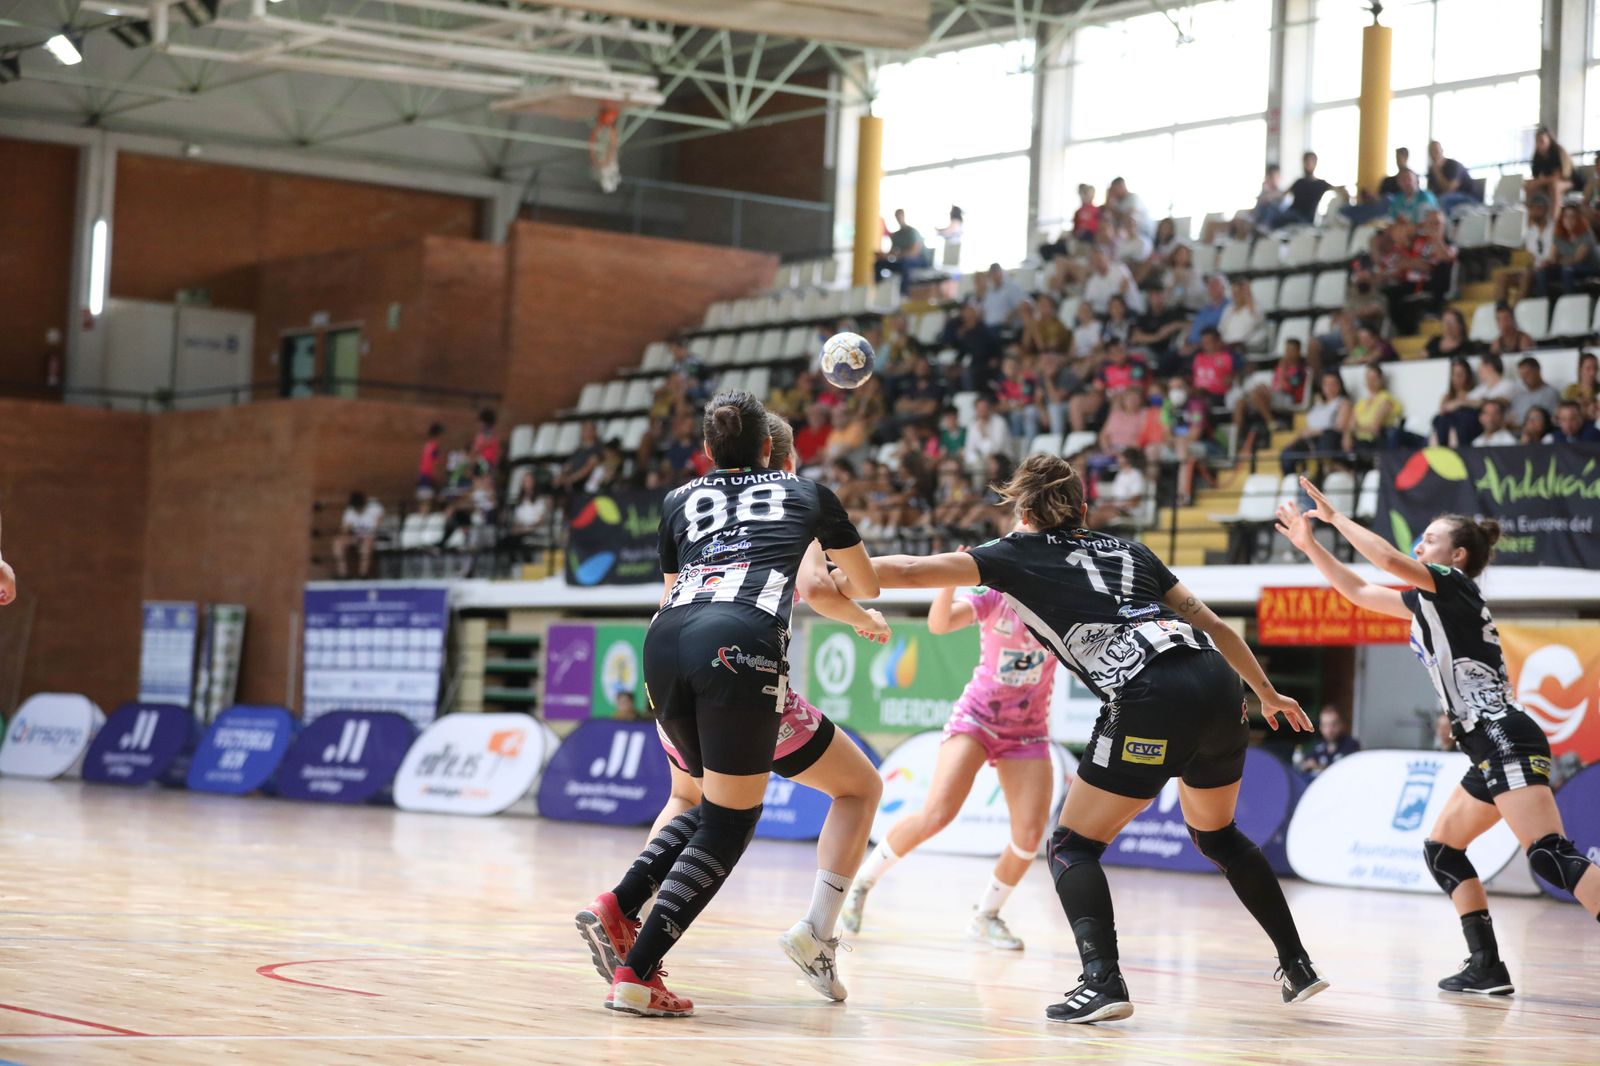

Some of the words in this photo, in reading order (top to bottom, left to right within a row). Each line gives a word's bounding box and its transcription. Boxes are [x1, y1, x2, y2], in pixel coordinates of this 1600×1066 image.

[673, 476, 727, 498] PAULA
[684, 483, 787, 542] 88
[1065, 548, 1135, 604] 17
[1261, 590, 1353, 621] PATATAS
